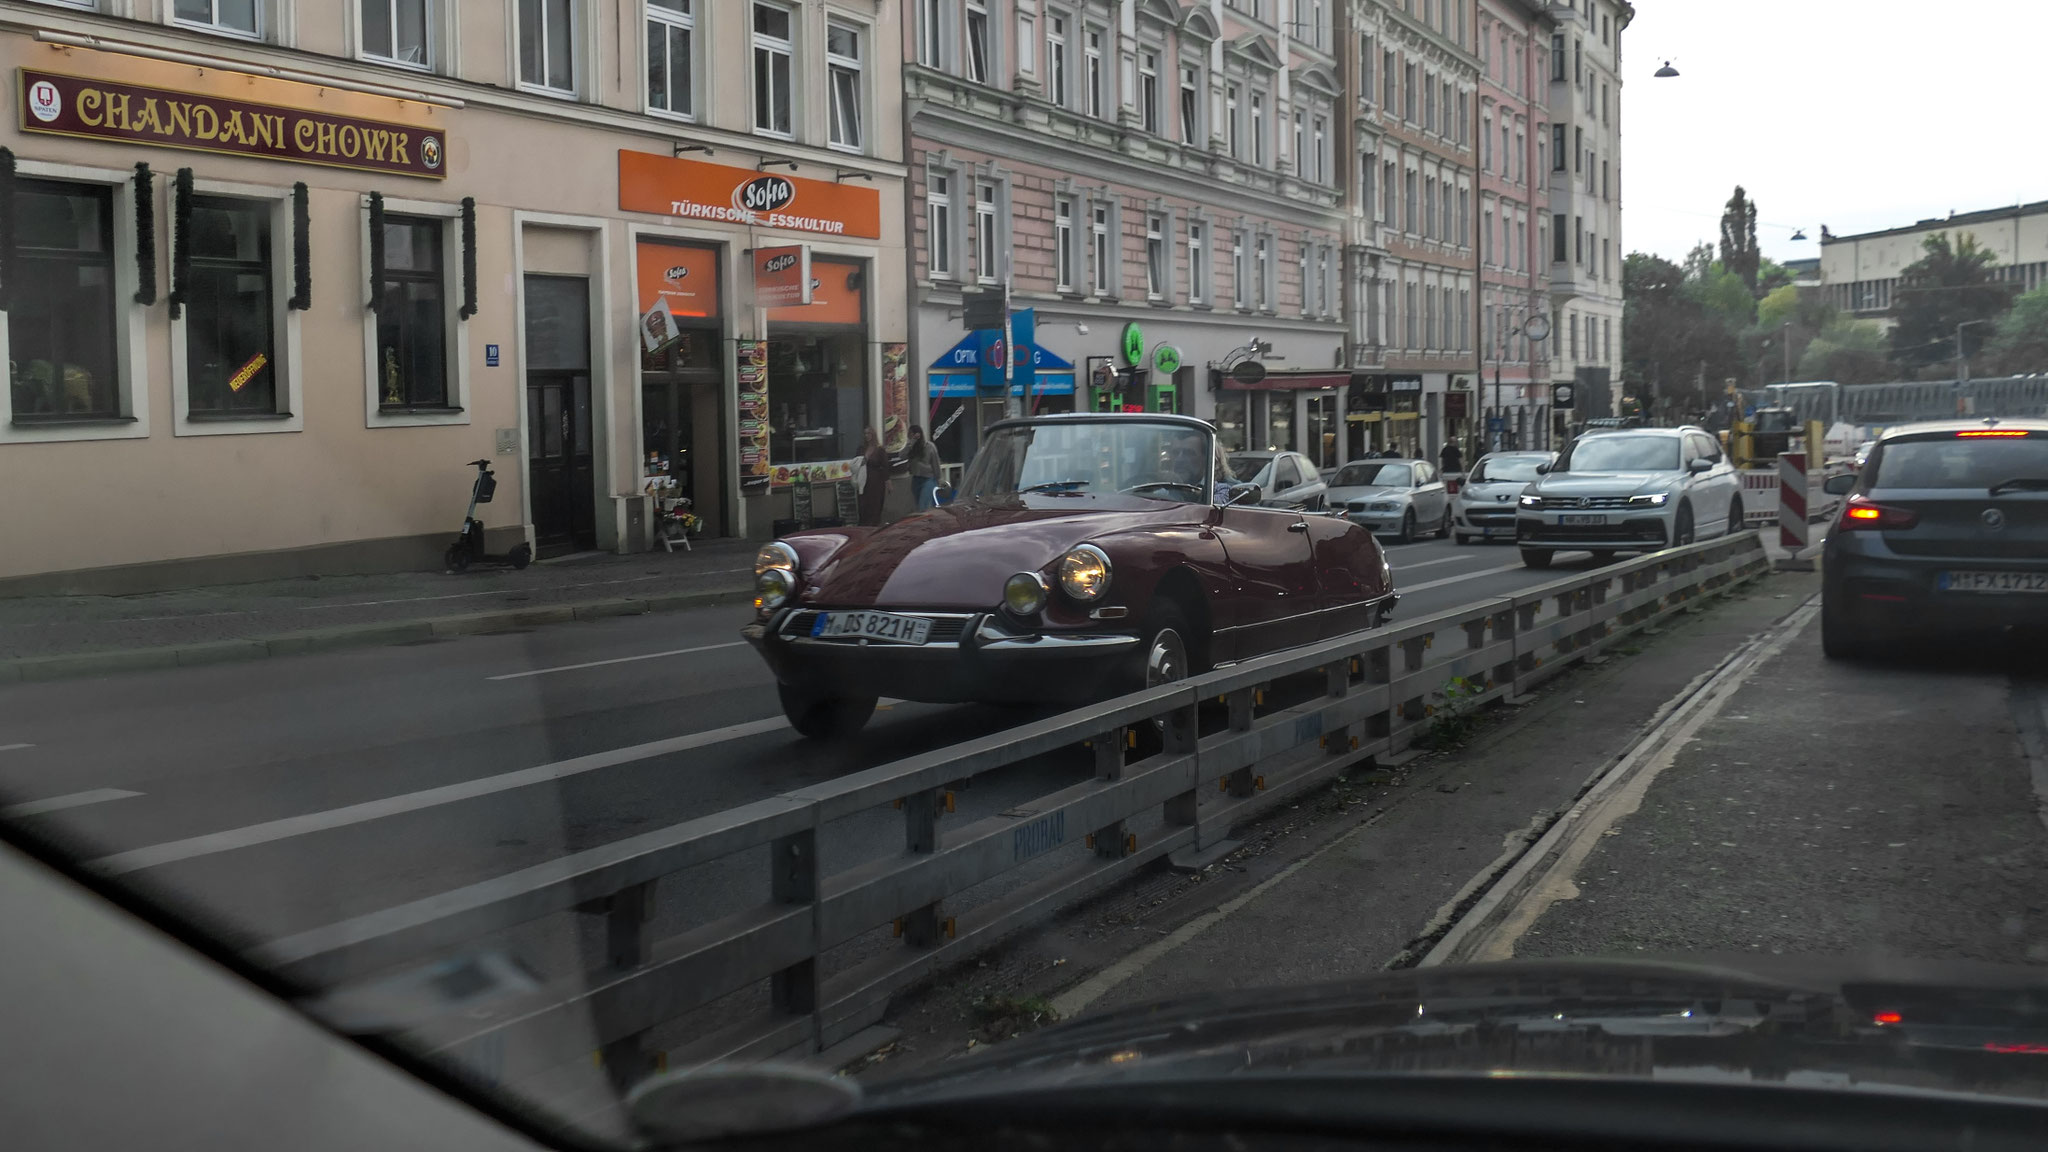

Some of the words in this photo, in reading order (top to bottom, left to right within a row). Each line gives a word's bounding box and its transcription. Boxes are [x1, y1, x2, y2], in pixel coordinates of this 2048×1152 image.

[76, 88, 286, 149] CHANDANI
[294, 118, 411, 165] CHOWK
[671, 200, 756, 224] TÜRKISCHE
[769, 213, 844, 234] ESSKULTUR
[489, 346, 498, 357] 10
[954, 349, 978, 364] OPTIK
[2001, 573, 2046, 590] 1712
[842, 614, 865, 633] DS
[866, 615, 916, 640] 821H
[1014, 811, 1064, 862] PROBAU
